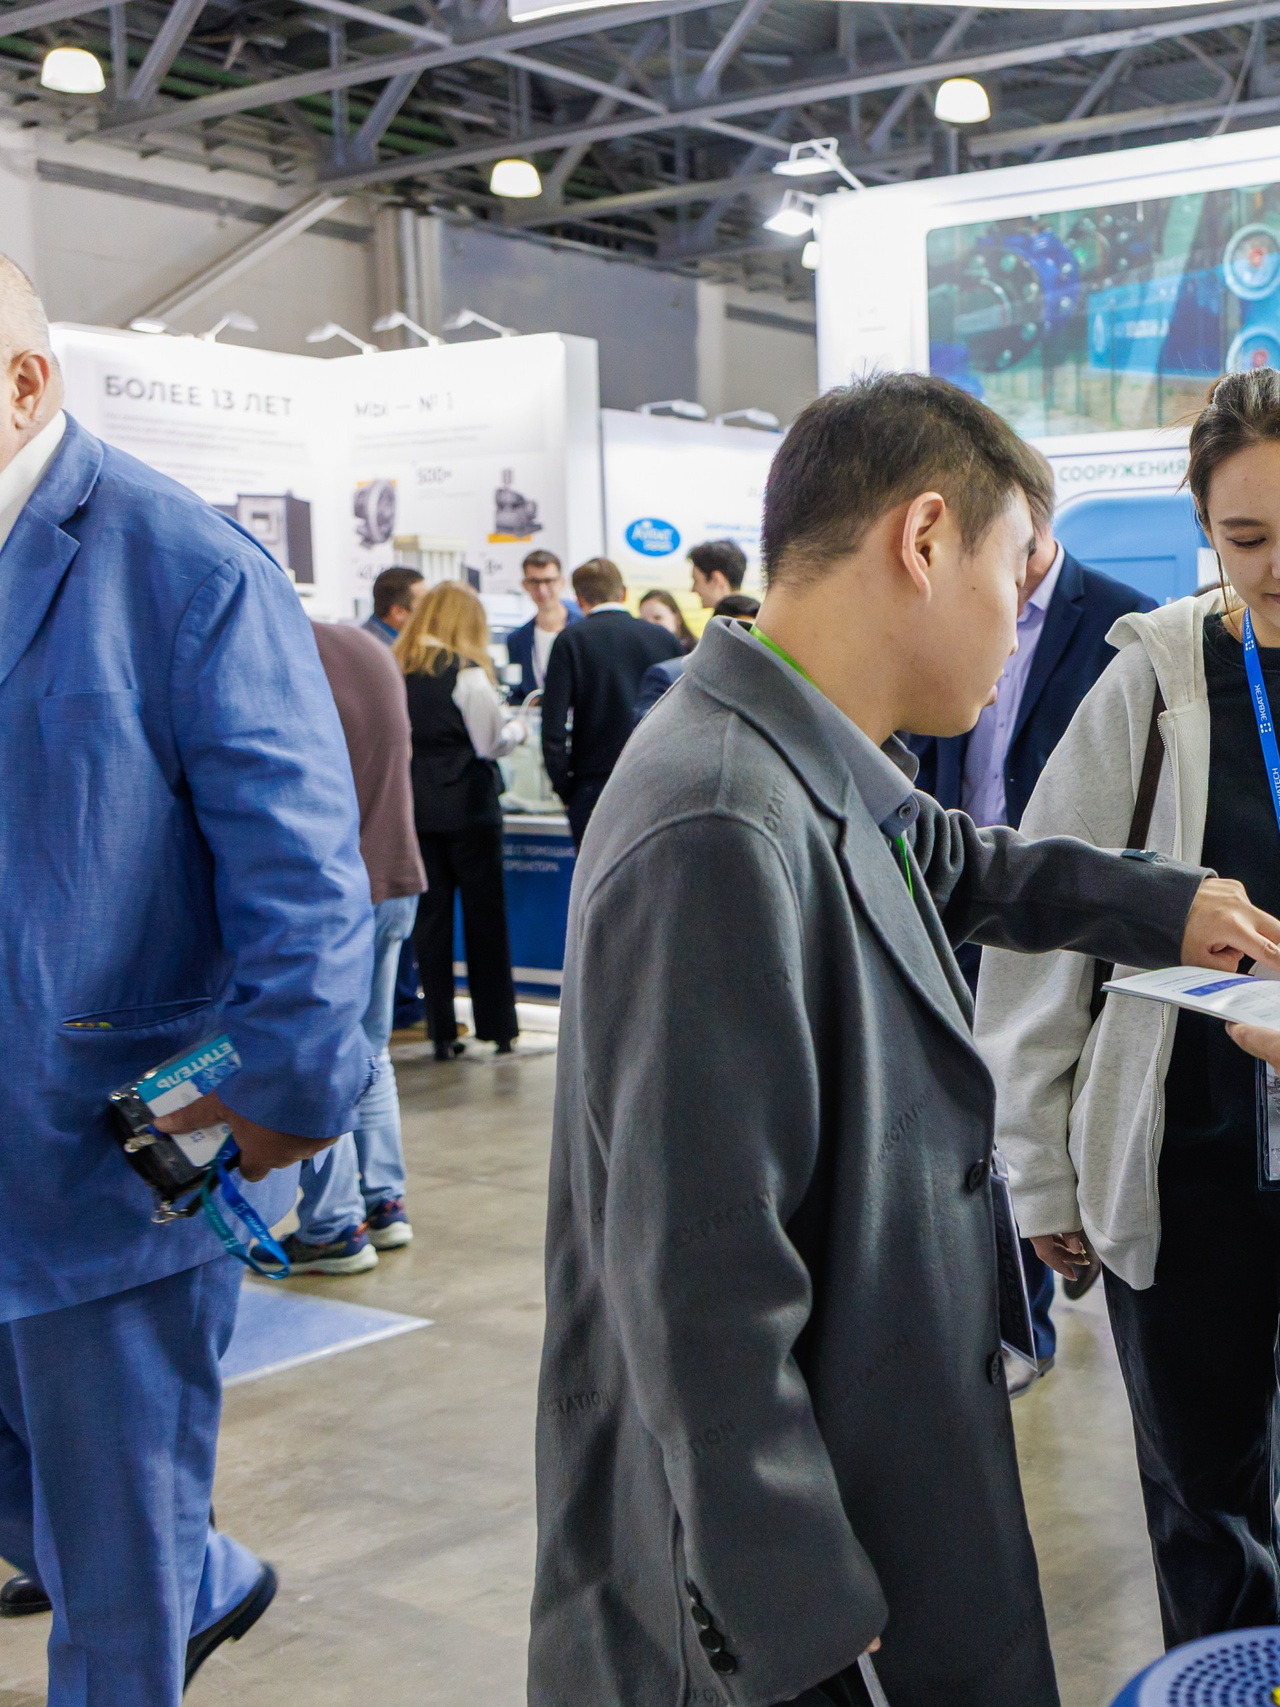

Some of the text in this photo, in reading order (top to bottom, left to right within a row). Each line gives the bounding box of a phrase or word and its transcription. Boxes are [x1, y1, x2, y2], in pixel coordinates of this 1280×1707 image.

[104, 375, 292, 416] БОЛЕЕ 13 ЛЕТ
[1059, 458, 1188, 482] СООРУЖЕНИЯ
[156, 1041, 234, 1089] ЕТИТЕЛЬ
